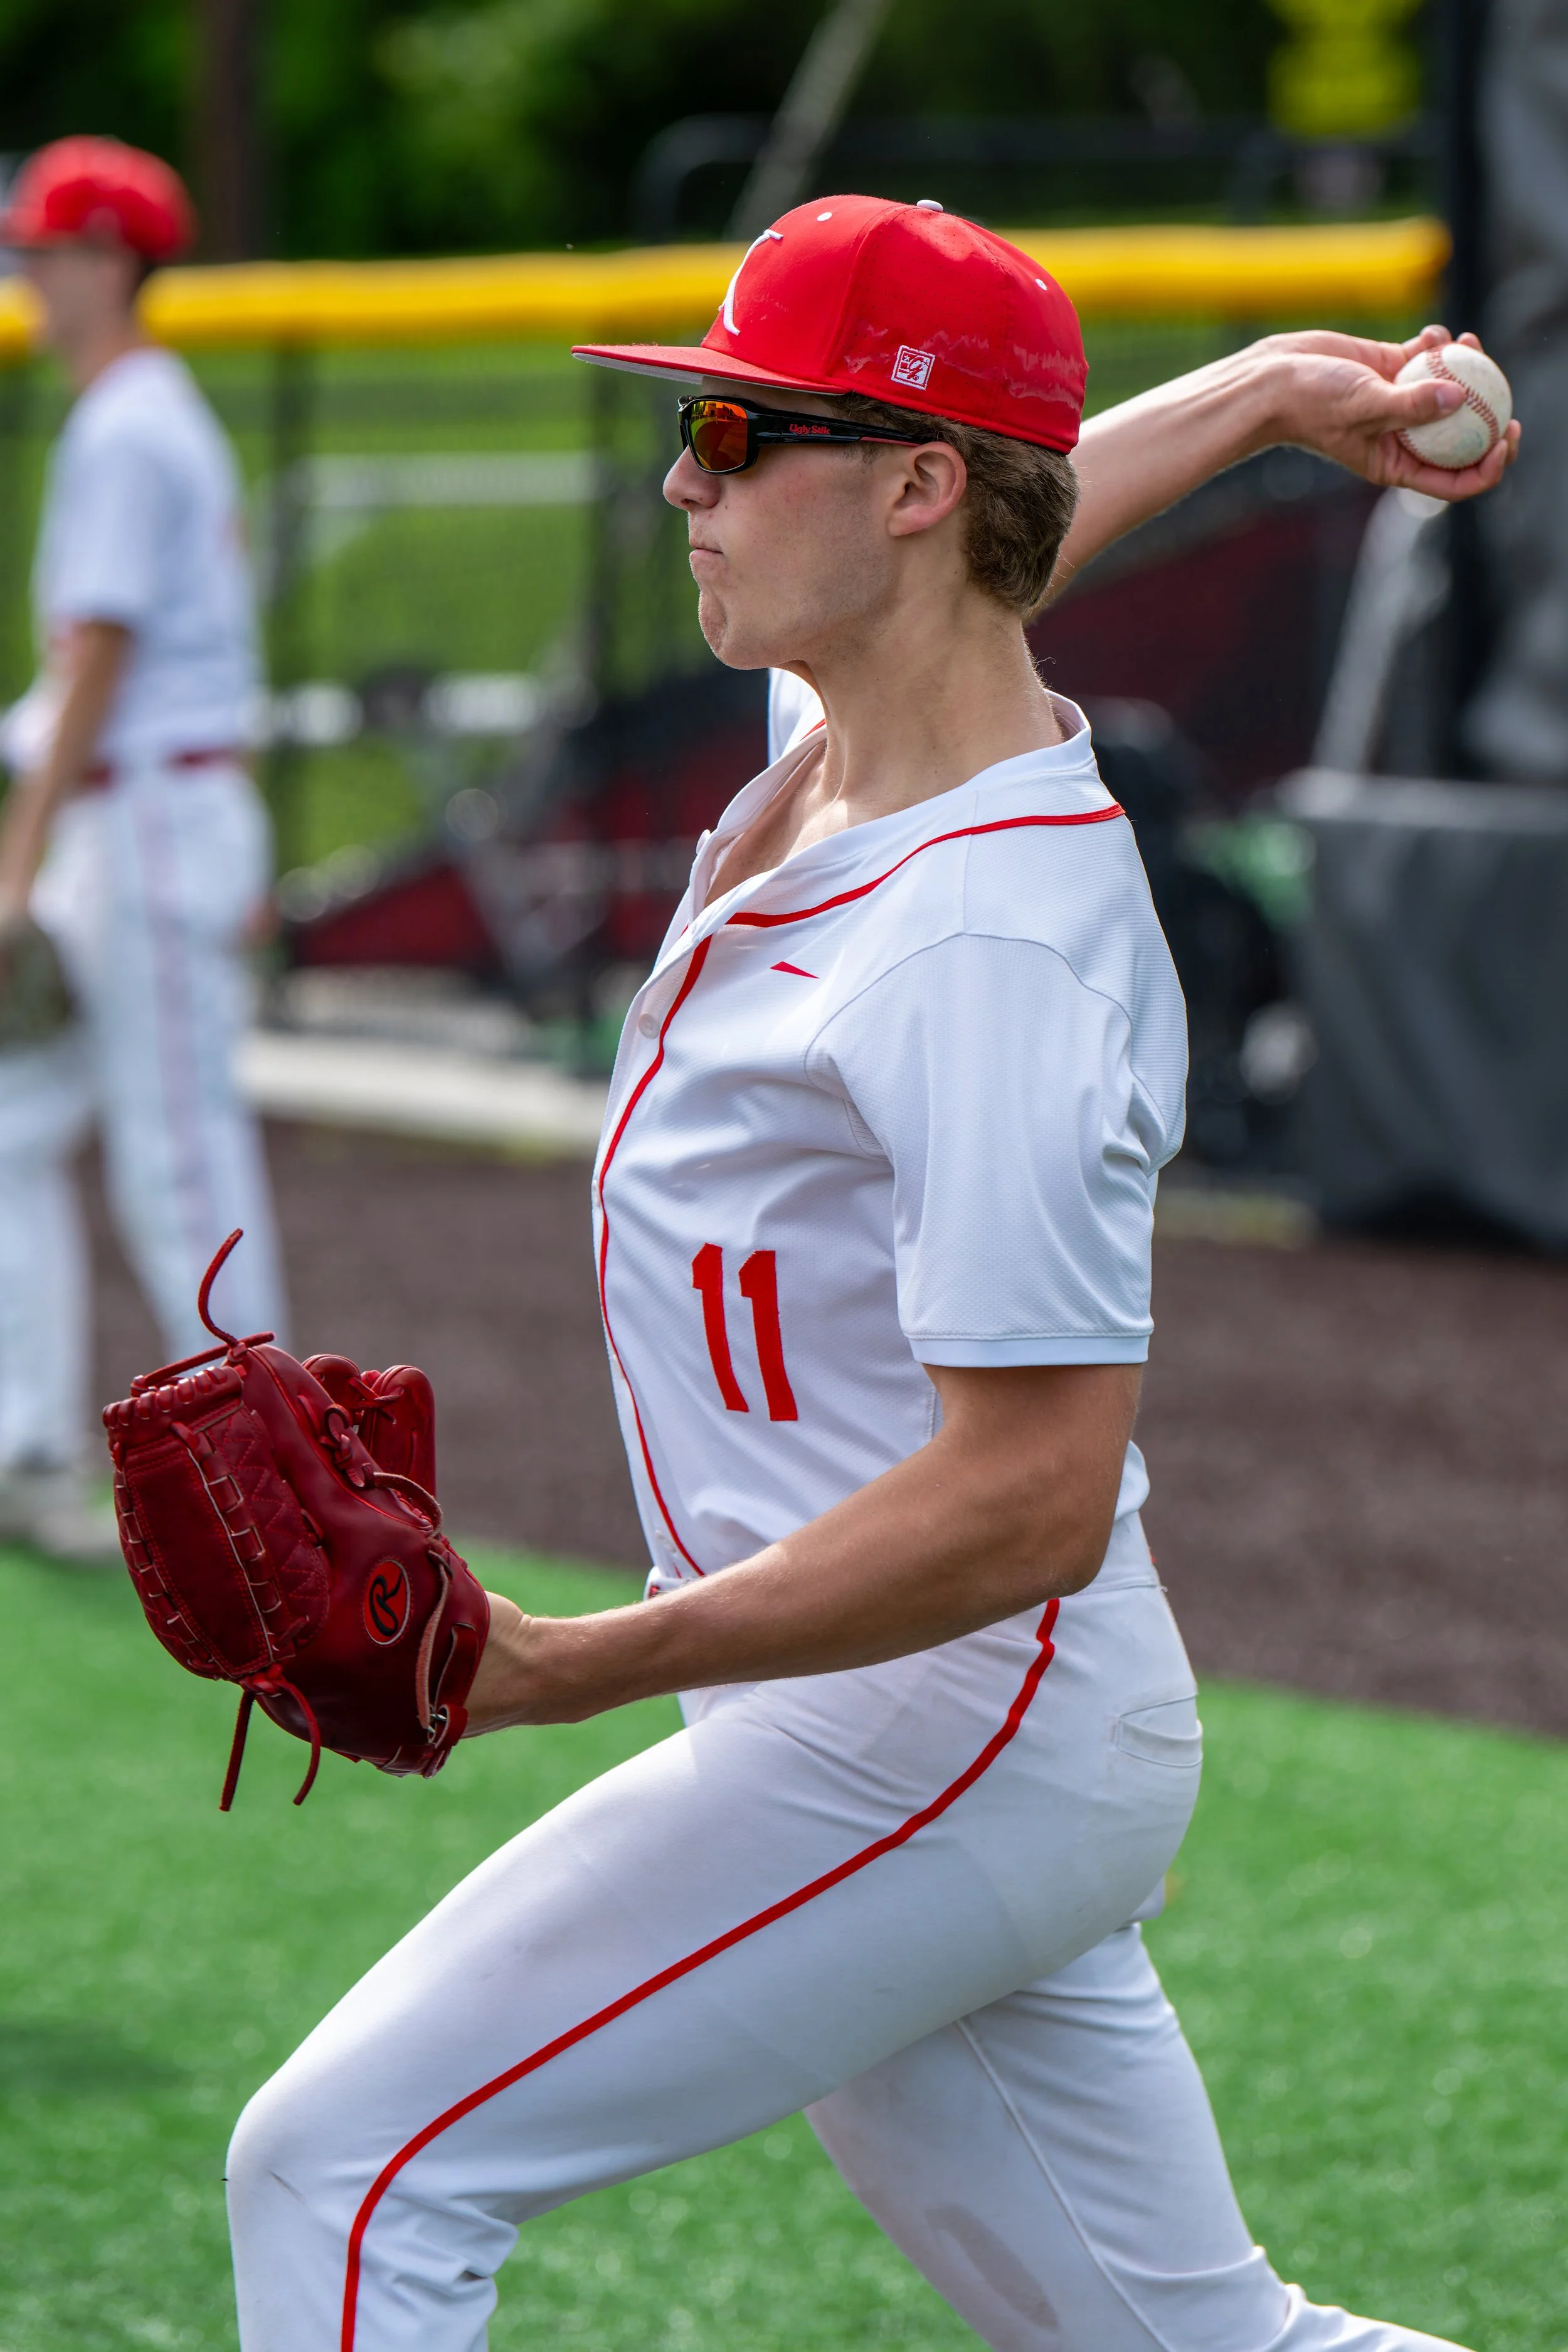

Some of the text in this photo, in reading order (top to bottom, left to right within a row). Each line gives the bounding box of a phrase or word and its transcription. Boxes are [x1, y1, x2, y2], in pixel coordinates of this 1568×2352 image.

[789, 423, 831, 435] Ugly Stik
[691, 1242, 798, 1421] 11
